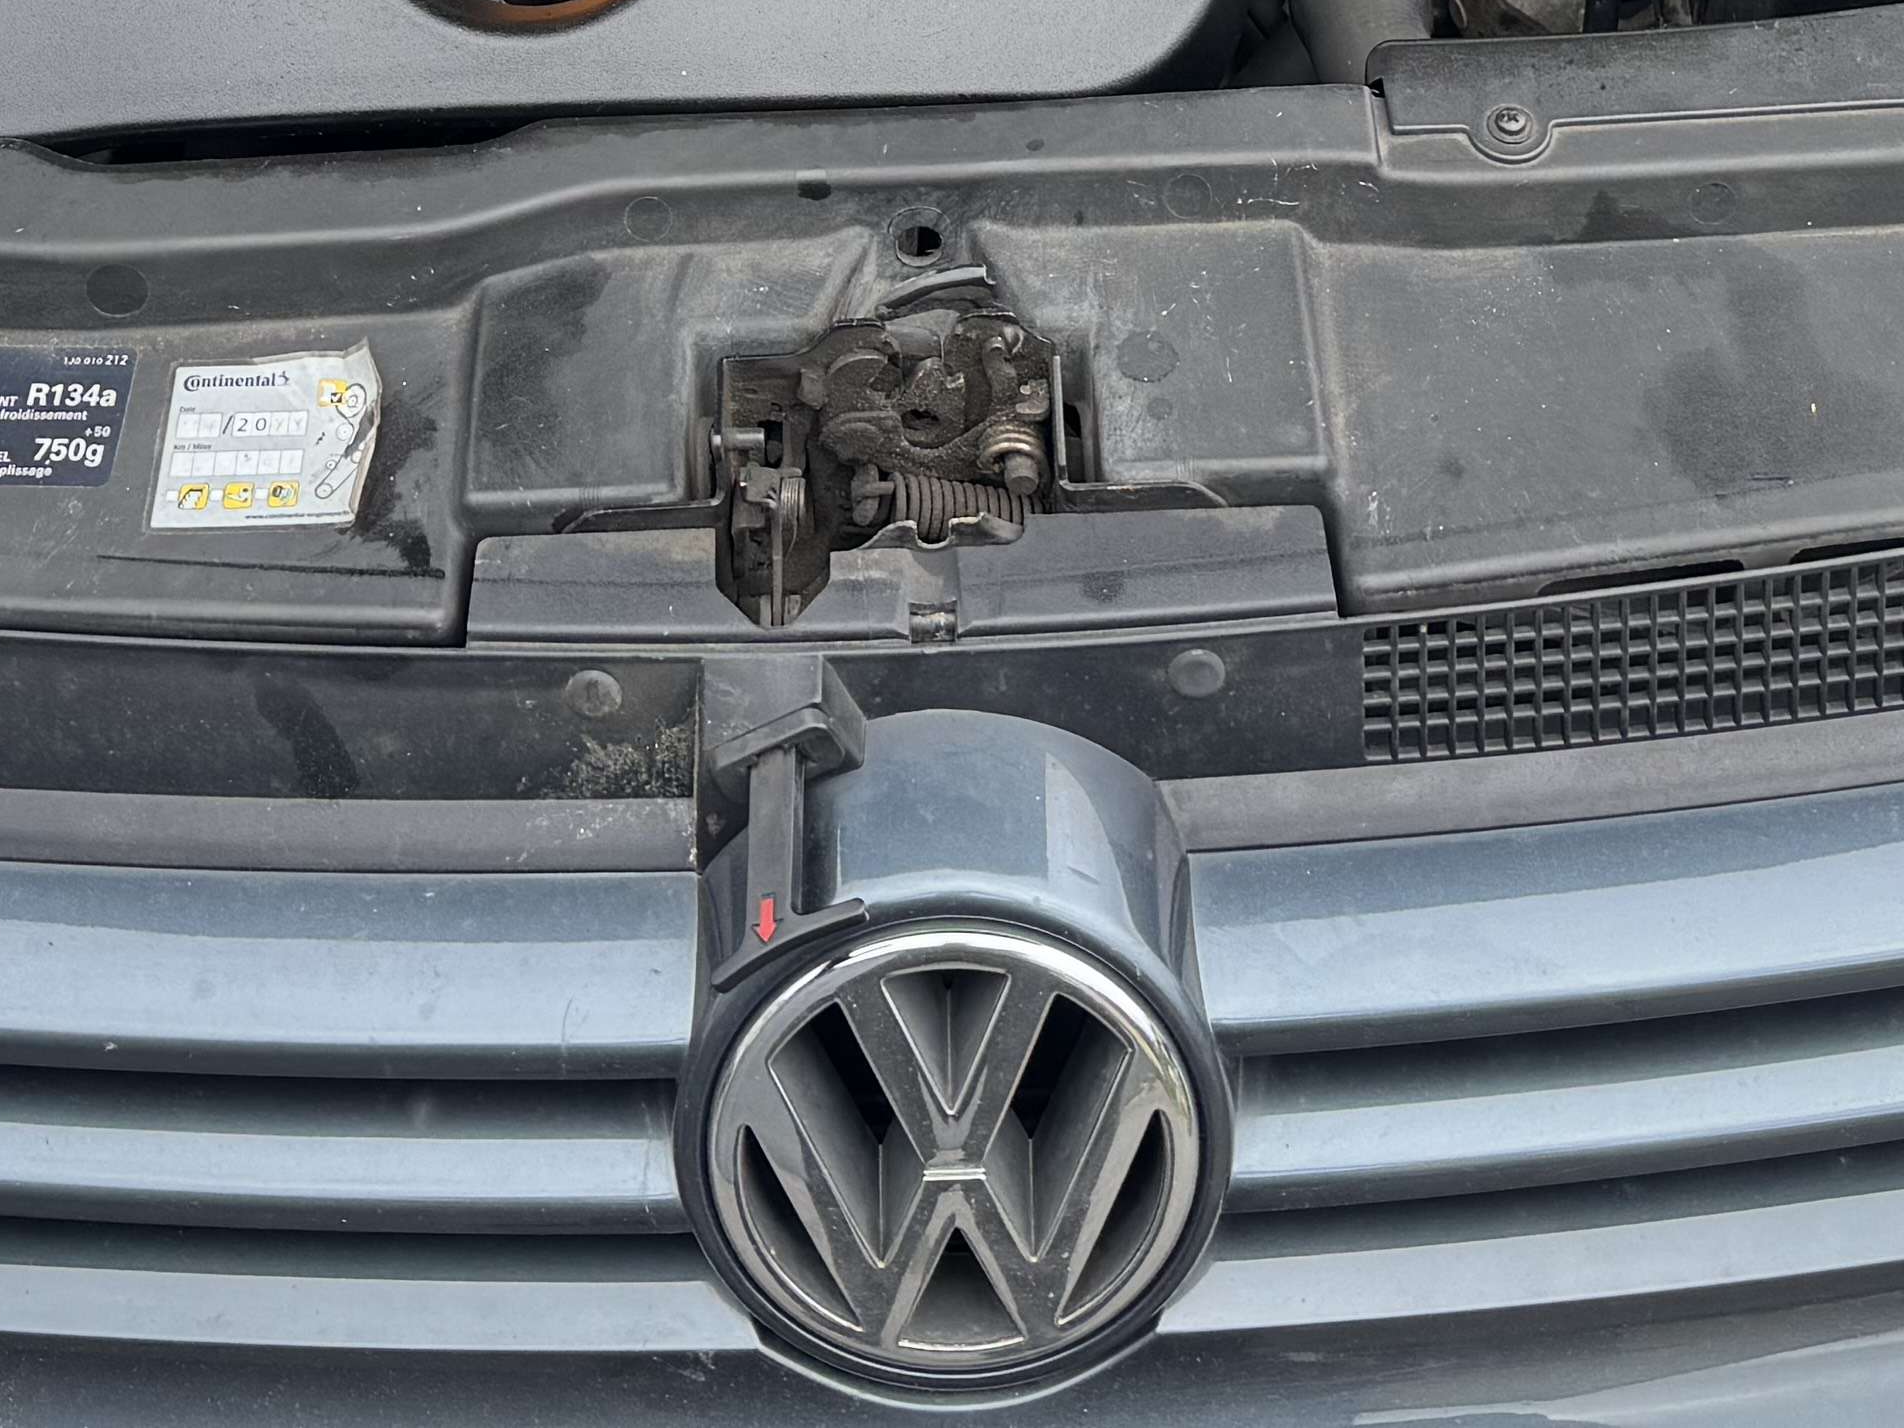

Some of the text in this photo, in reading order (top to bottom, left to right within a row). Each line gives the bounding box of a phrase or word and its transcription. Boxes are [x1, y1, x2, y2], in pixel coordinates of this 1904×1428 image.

[105, 354, 129, 366] 212
[183, 373, 277, 392] Continental
[26, 382, 118, 407] R134a
[84, 426, 111, 438] +50
[33, 437, 105, 468] 750g
